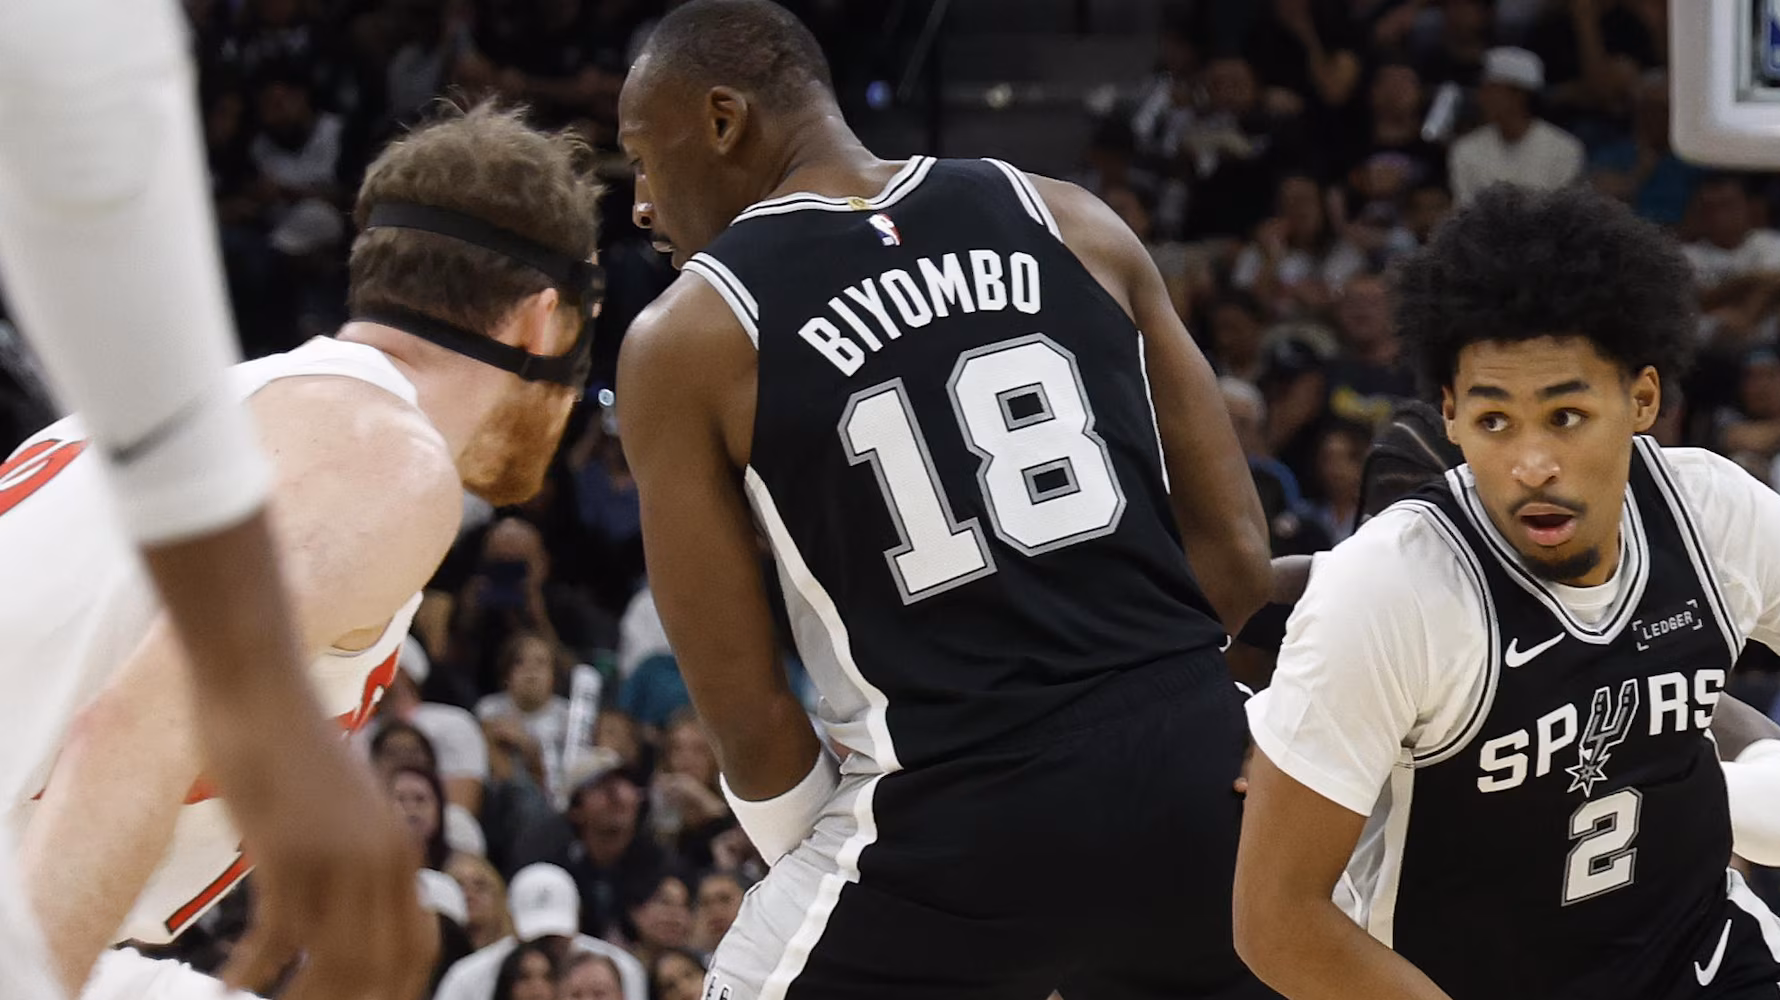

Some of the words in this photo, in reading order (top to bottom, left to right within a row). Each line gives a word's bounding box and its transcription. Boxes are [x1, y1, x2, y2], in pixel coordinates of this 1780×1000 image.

[798, 249, 1041, 377] BIYOMBO
[837, 332, 1128, 606] 18
[1643, 610, 1694, 640] LEDGER
[1561, 786, 1643, 906] 2
